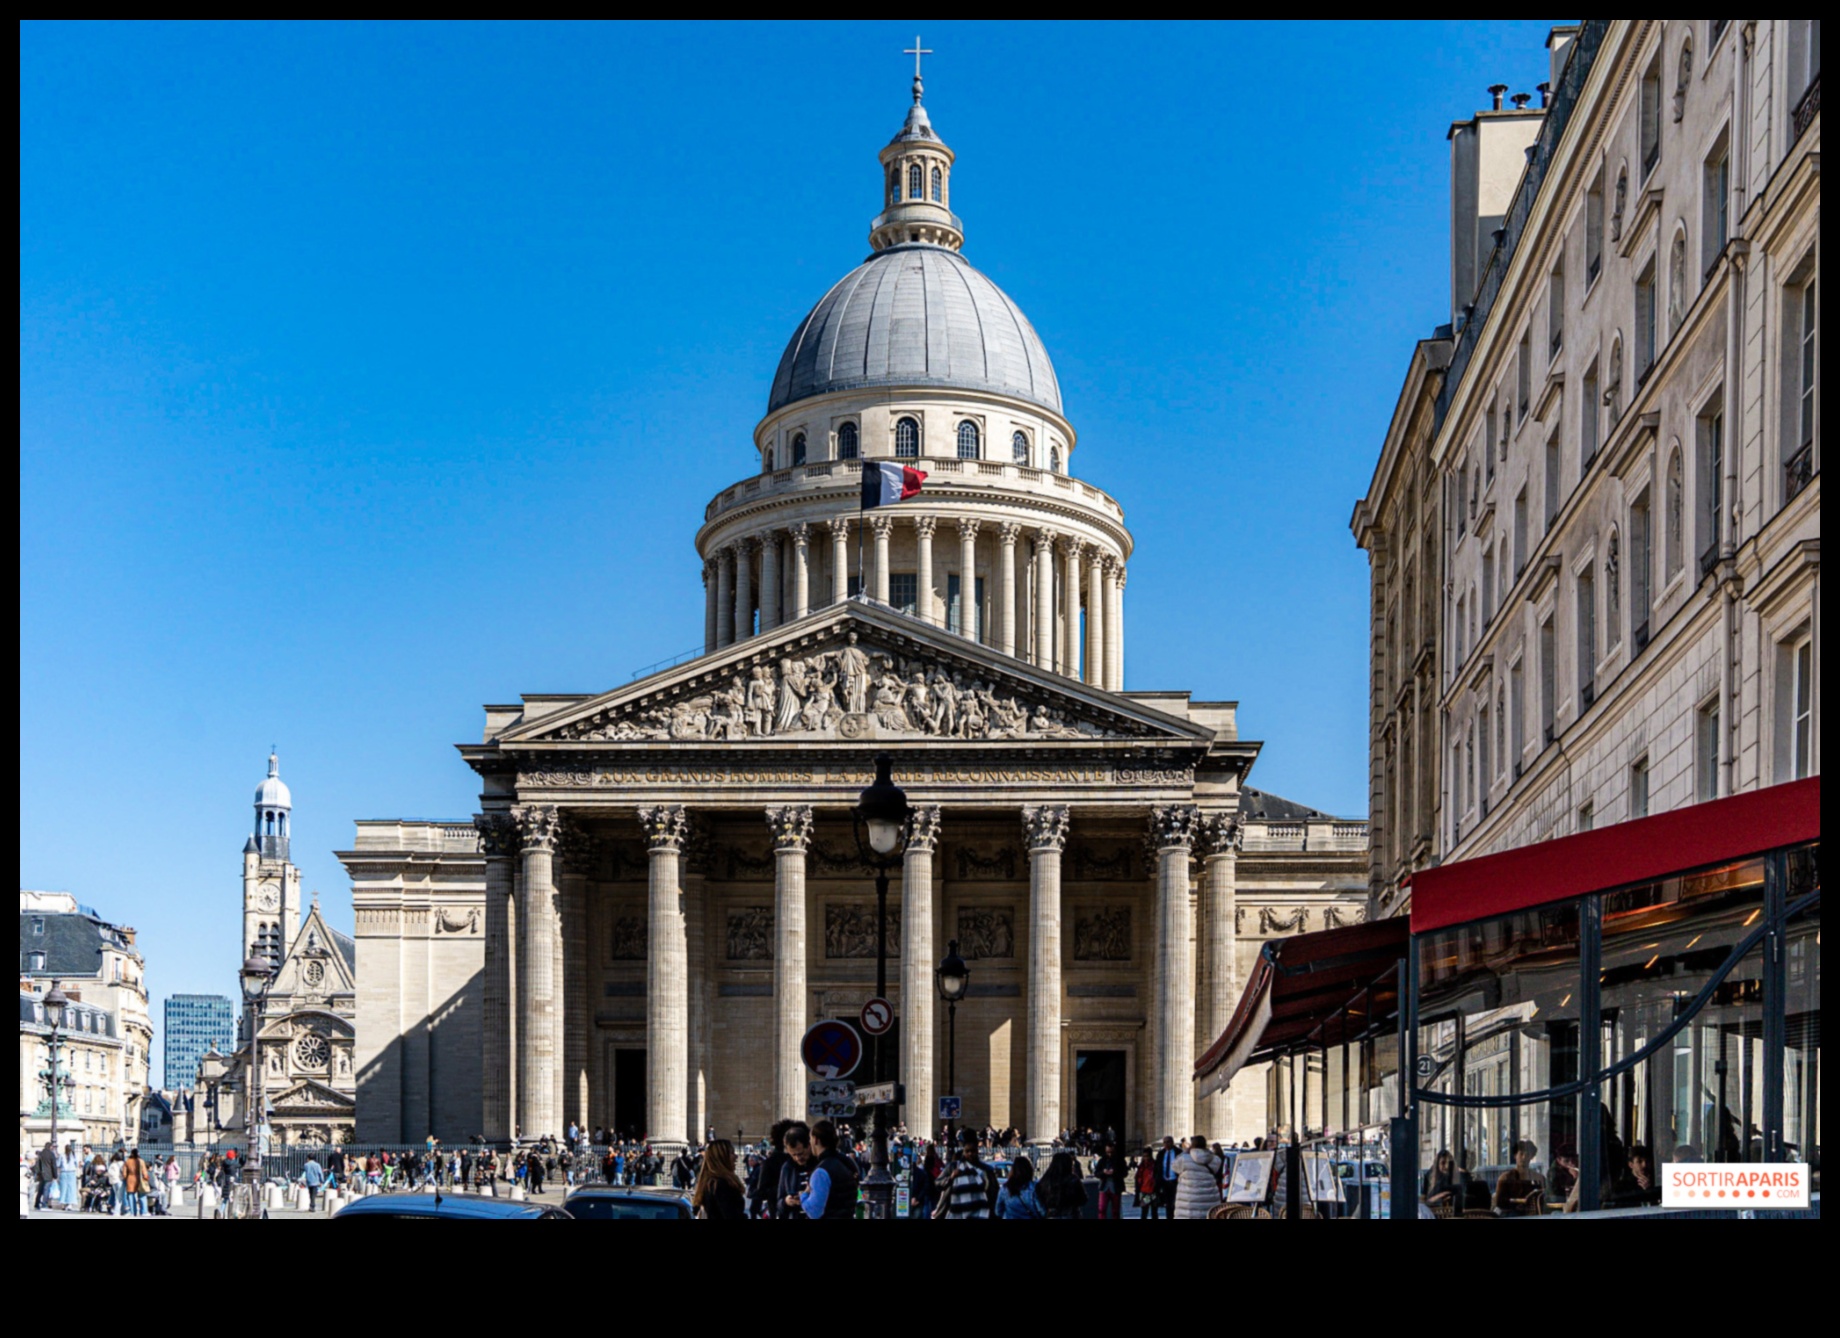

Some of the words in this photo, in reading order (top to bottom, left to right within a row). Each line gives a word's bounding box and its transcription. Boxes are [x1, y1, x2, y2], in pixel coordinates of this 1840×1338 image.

[599, 768, 642, 784] AUX
[645, 768, 727, 784] GRANDS
[729, 767, 815, 784] HOMMES
[824, 767, 850, 783] LA
[855, 767, 926, 783] PARIE
[932, 767, 1107, 783] RECONNAISSANTE
[1418, 1061, 1431, 1071] 21
